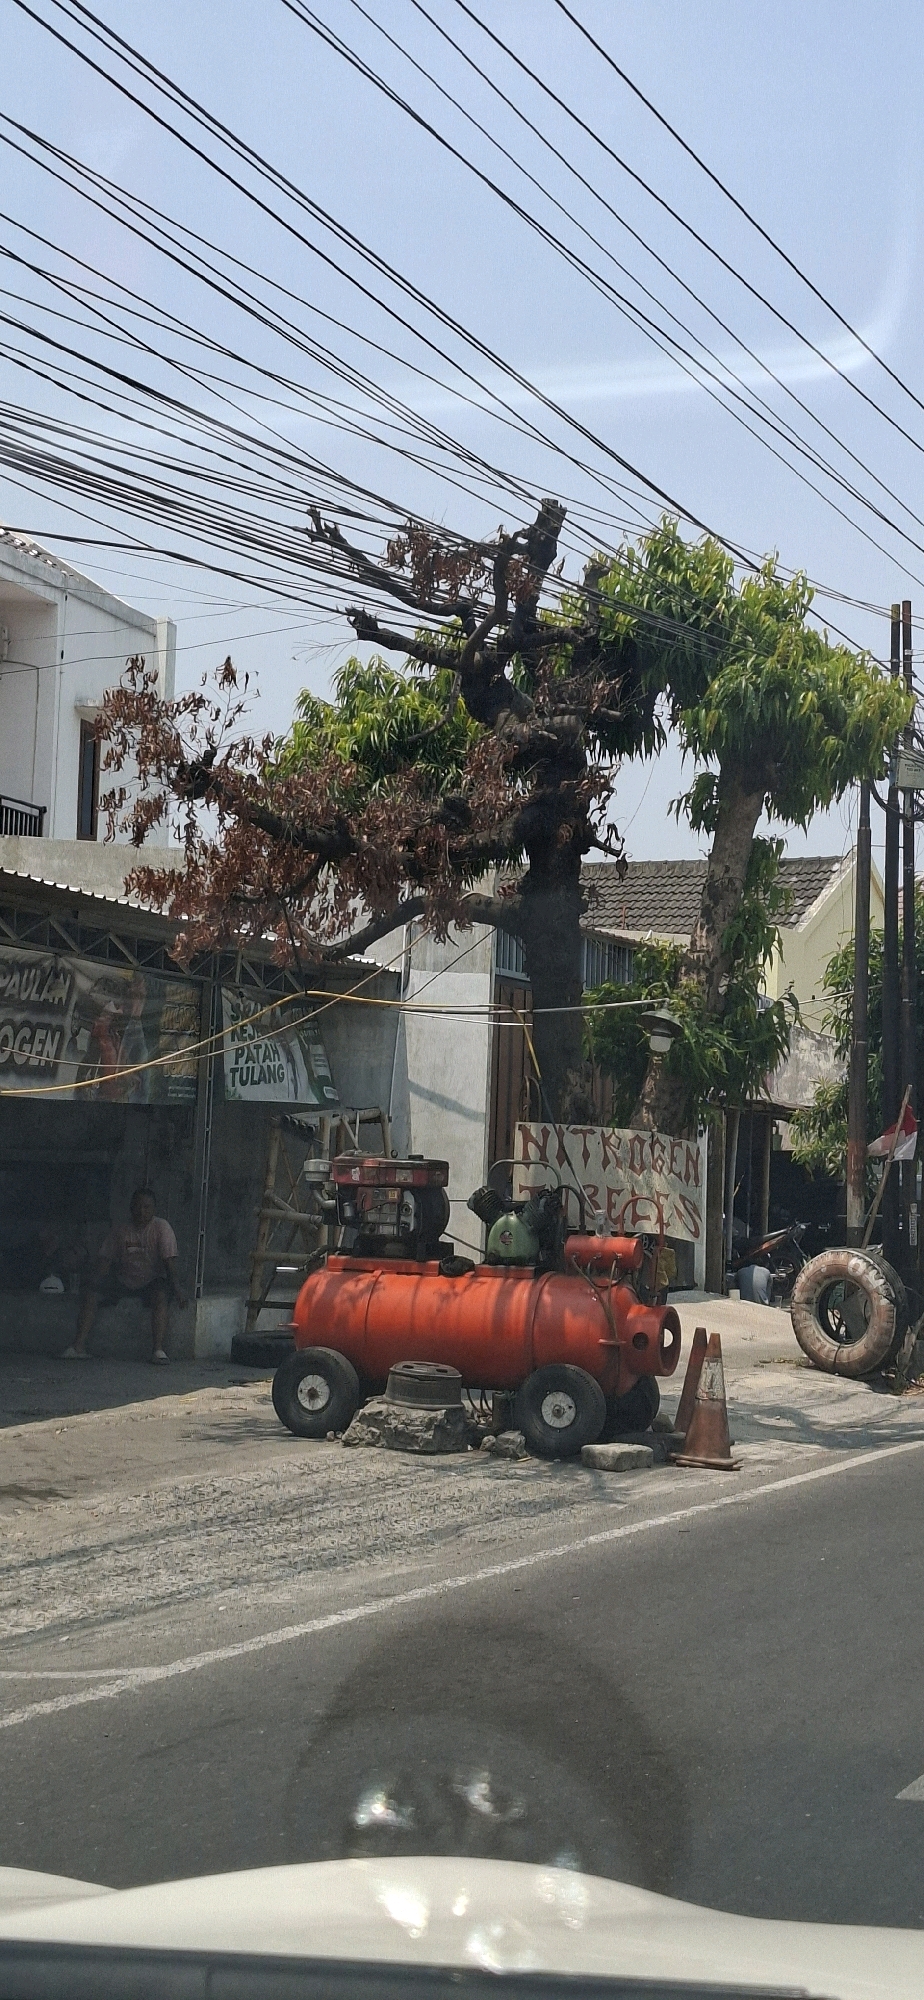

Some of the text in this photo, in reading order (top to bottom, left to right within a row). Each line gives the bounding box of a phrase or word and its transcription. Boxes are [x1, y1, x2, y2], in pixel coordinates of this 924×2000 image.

[234, 1042, 280, 1066] PATAH
[230, 1063, 285, 1088] TULANG
[518, 1124, 701, 1187] NITROGEN
